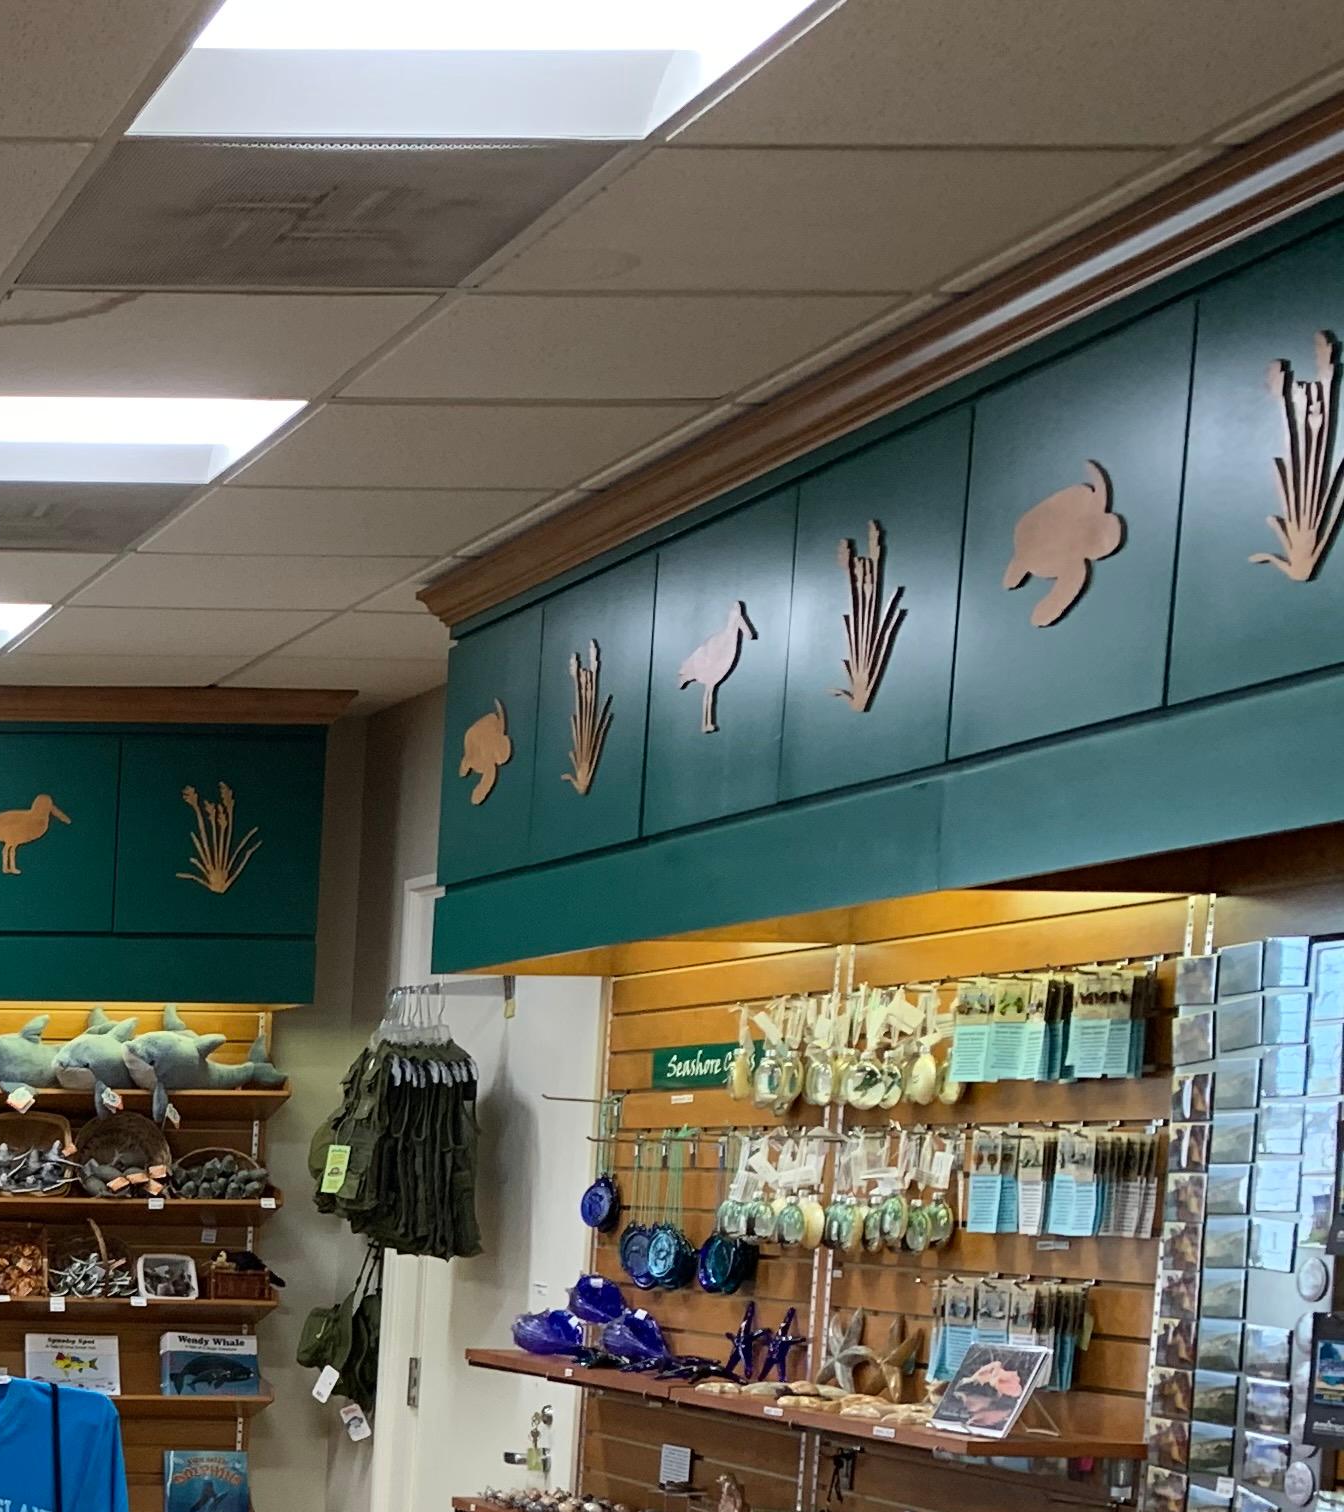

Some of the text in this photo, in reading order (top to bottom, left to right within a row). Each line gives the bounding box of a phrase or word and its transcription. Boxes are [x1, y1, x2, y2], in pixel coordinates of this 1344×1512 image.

[666, 1050, 722, 1078] Seashore
[178, 1335, 245, 1347] Wendy Whale
